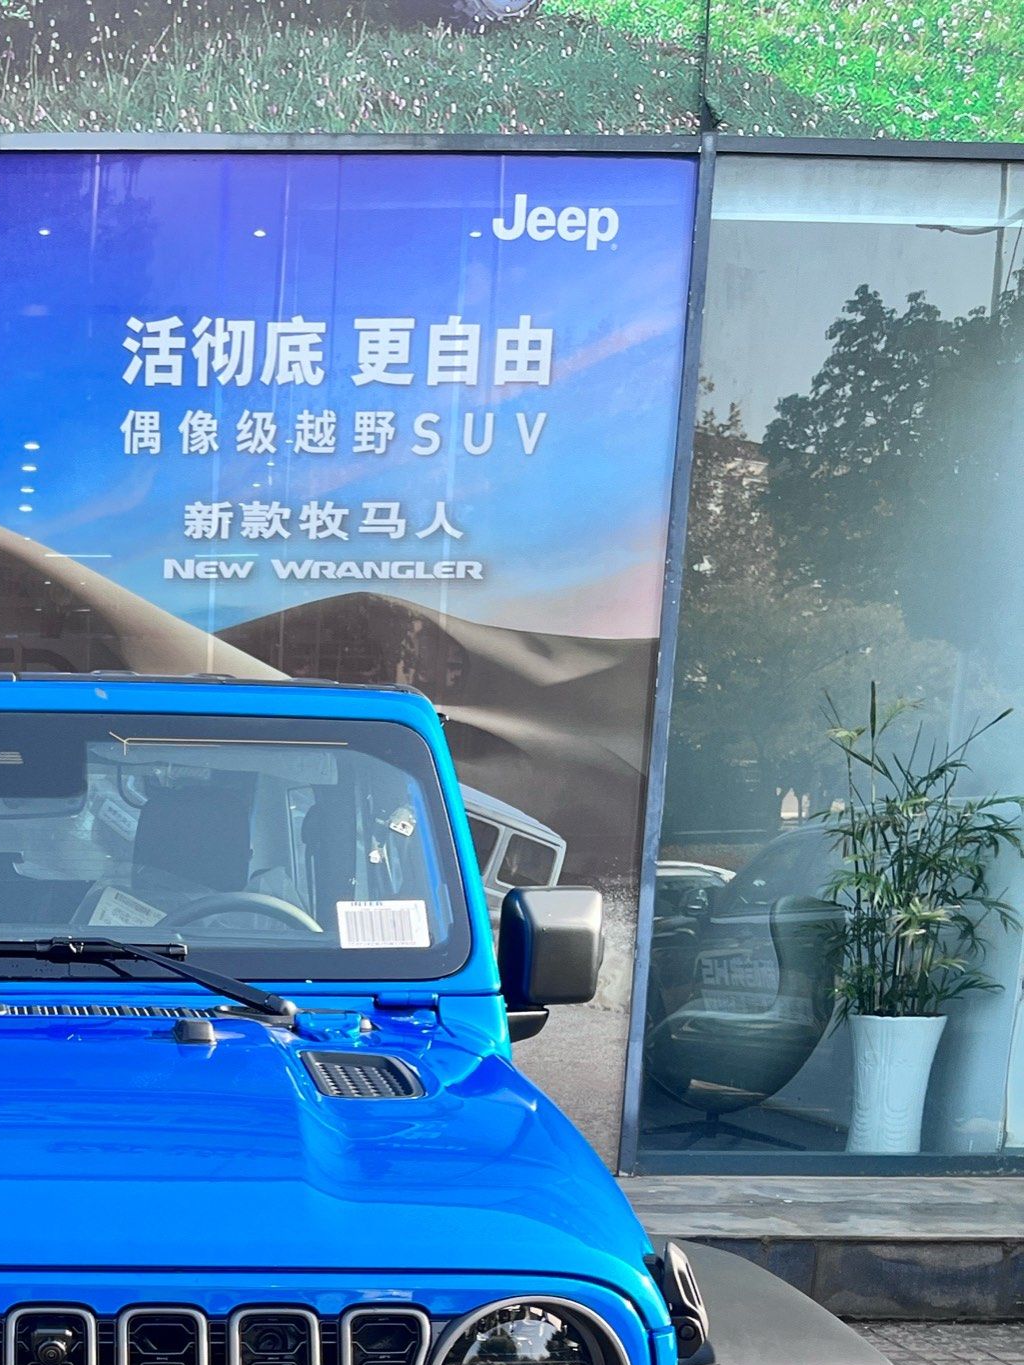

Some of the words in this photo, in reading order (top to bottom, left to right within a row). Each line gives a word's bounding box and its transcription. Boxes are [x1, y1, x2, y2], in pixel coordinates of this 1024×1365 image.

[492, 194, 618, 250] Jeep
[122, 315, 326, 387] 活彻底
[351, 314, 554, 387] 更自由
[120, 410, 547, 455] 偶像级越野SUV
[184, 501, 464, 540] 新款牧马人
